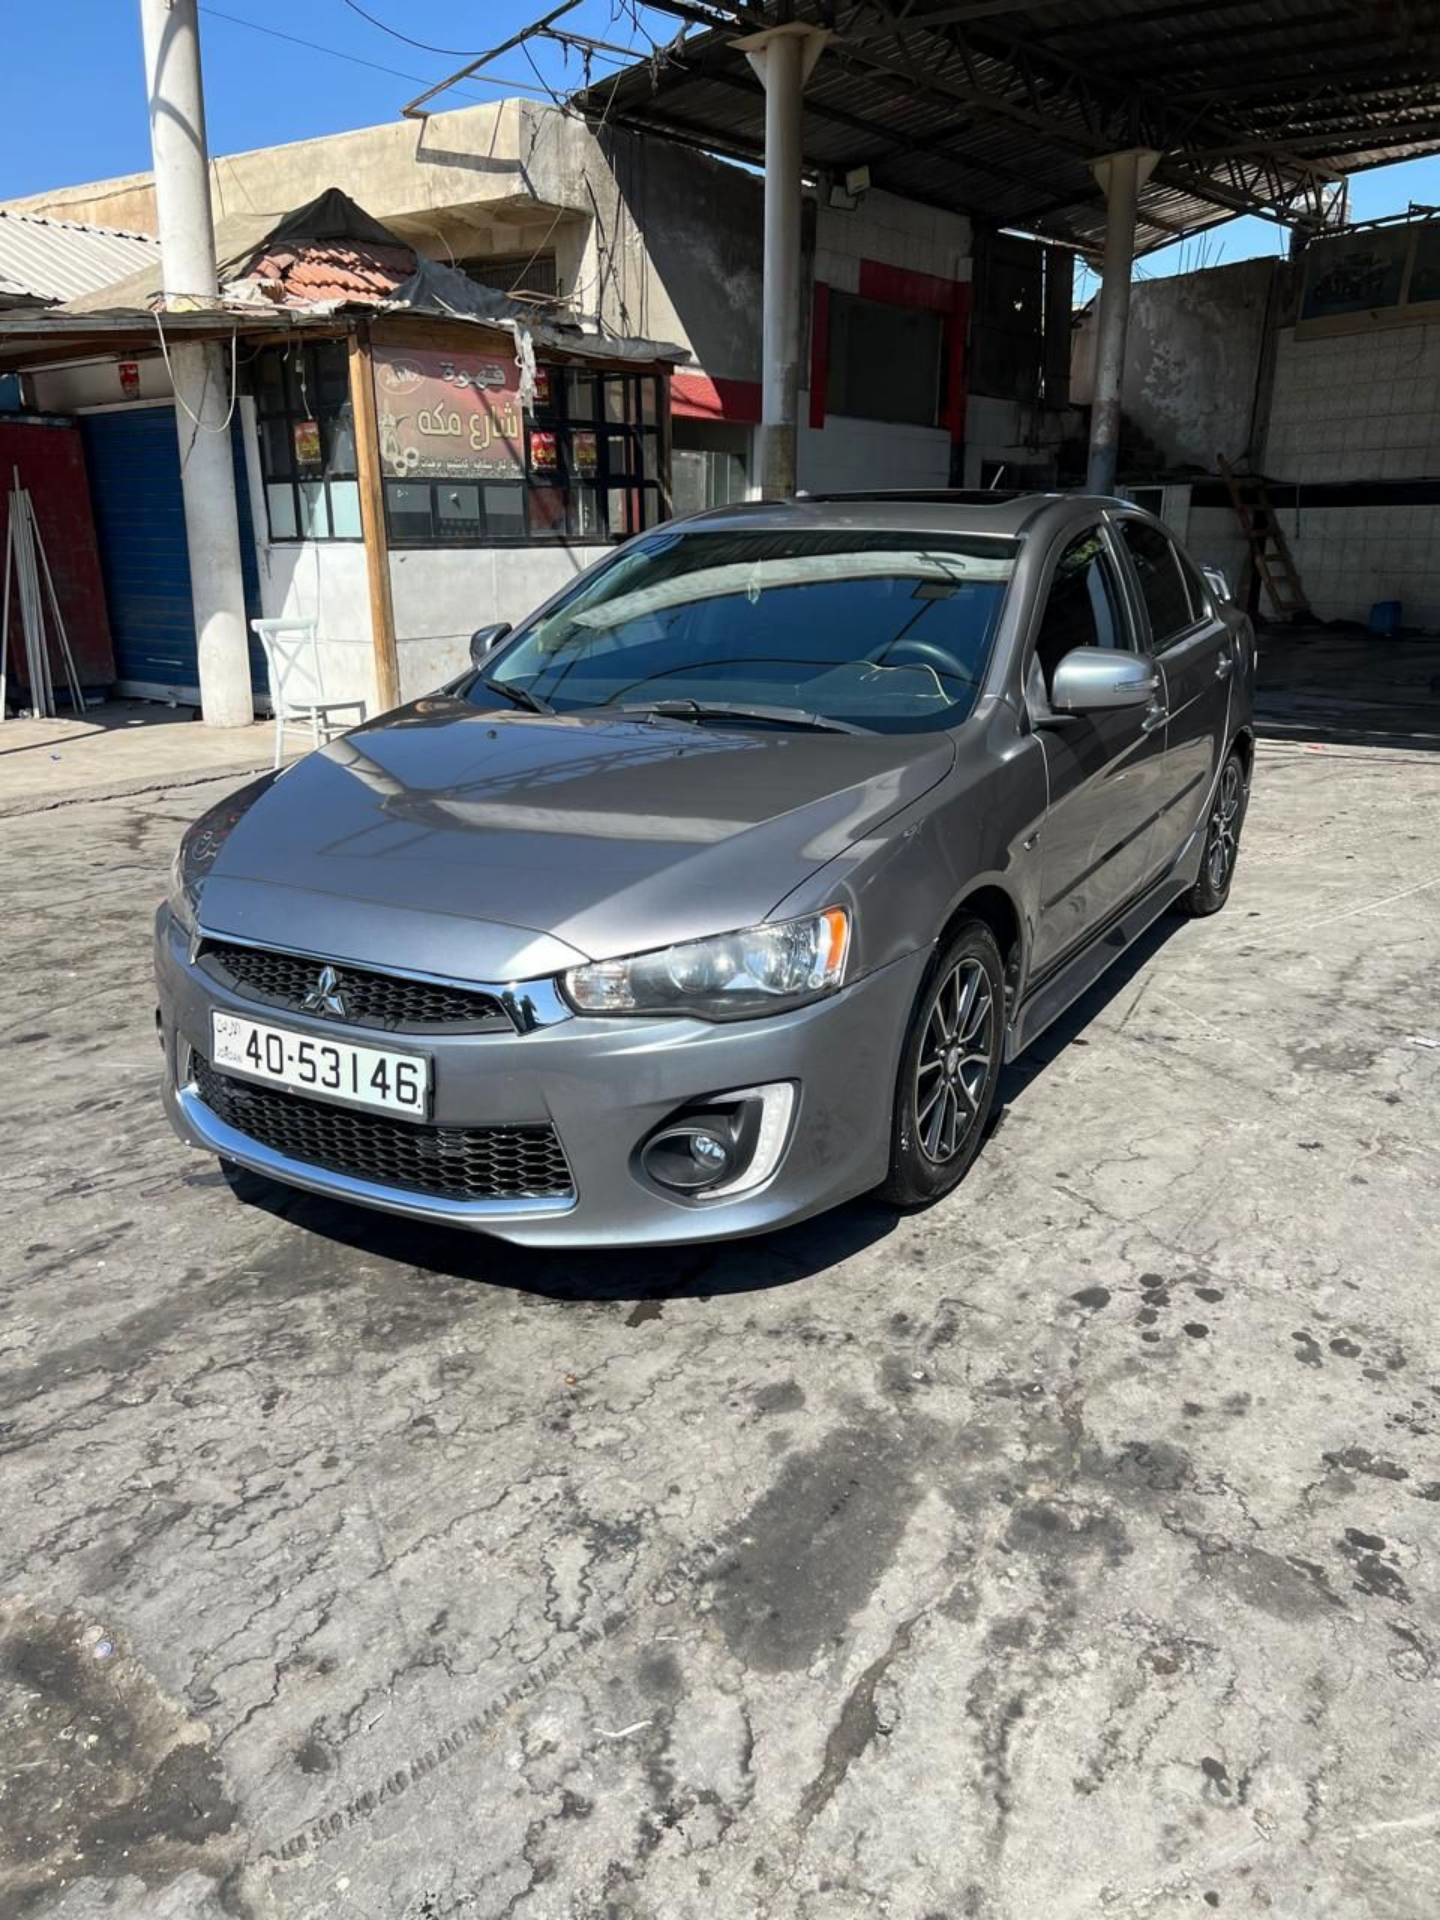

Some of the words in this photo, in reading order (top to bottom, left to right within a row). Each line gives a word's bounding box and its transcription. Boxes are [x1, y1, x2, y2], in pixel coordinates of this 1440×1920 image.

[440, 362, 506, 389] قهوة
[418, 401, 463, 436] مكه
[469, 402, 518, 449] شارع
[246, 1029, 418, 1105] 40-53146
